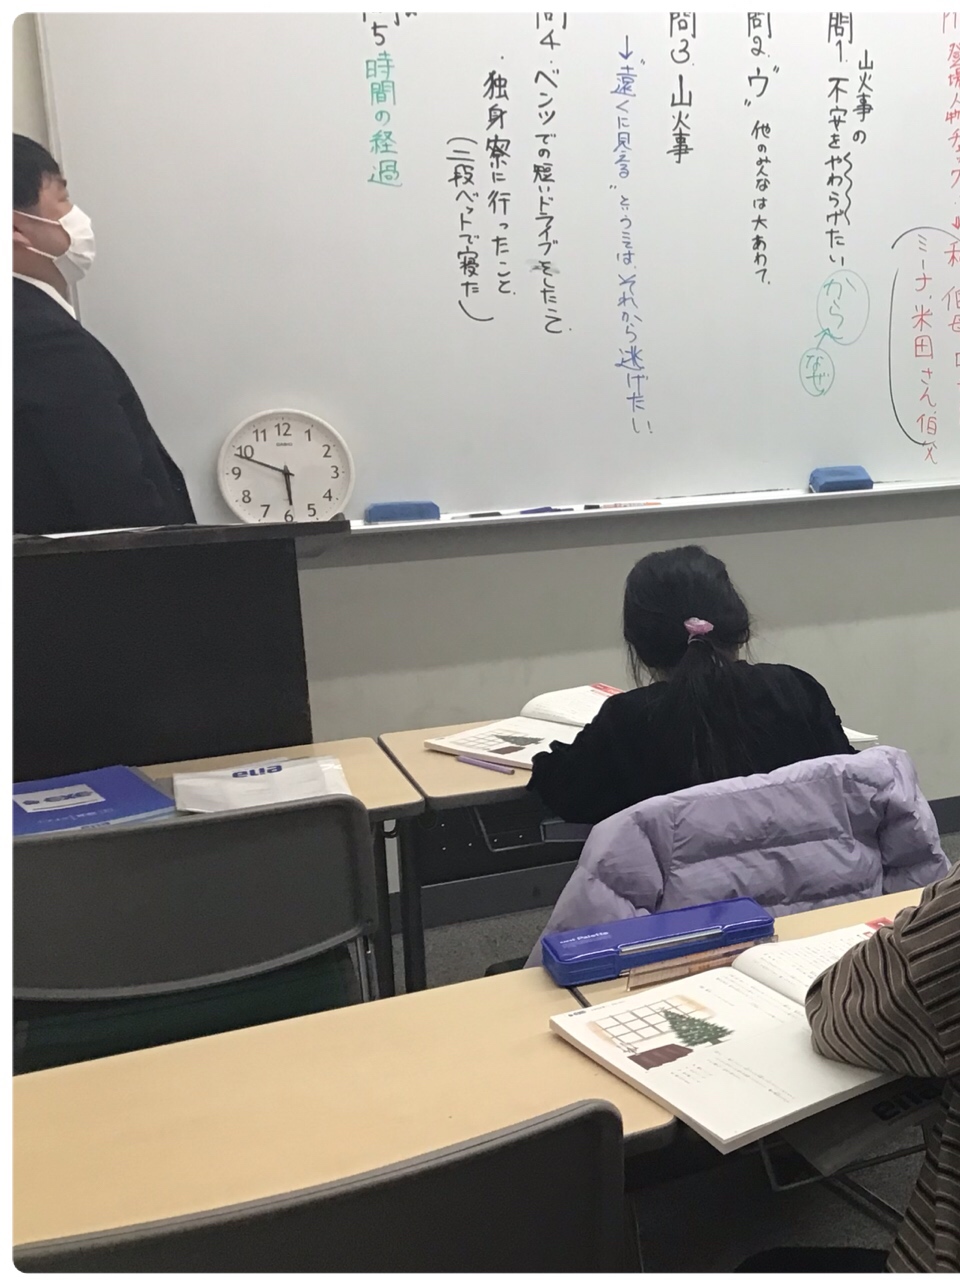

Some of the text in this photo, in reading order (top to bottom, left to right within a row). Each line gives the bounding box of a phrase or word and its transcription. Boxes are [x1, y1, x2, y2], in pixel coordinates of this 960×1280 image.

[852, 49, 874, 145] 山火事の
[364, 50, 402, 188] 時間の経過
[252, 428, 267, 442] 11
[274, 422, 291, 437] 12
[304, 428, 312, 441] 1
[236, 444, 254, 459] 10
[322, 445, 332, 458] 2
[231, 466, 241, 480] 9
[330, 465, 340, 479] 3
[241, 489, 252, 503] 8
[322, 488, 333, 502] 4
[260, 504, 270, 518] 7
[284, 509, 294, 522] 6
[307, 503, 317, 517] 5
